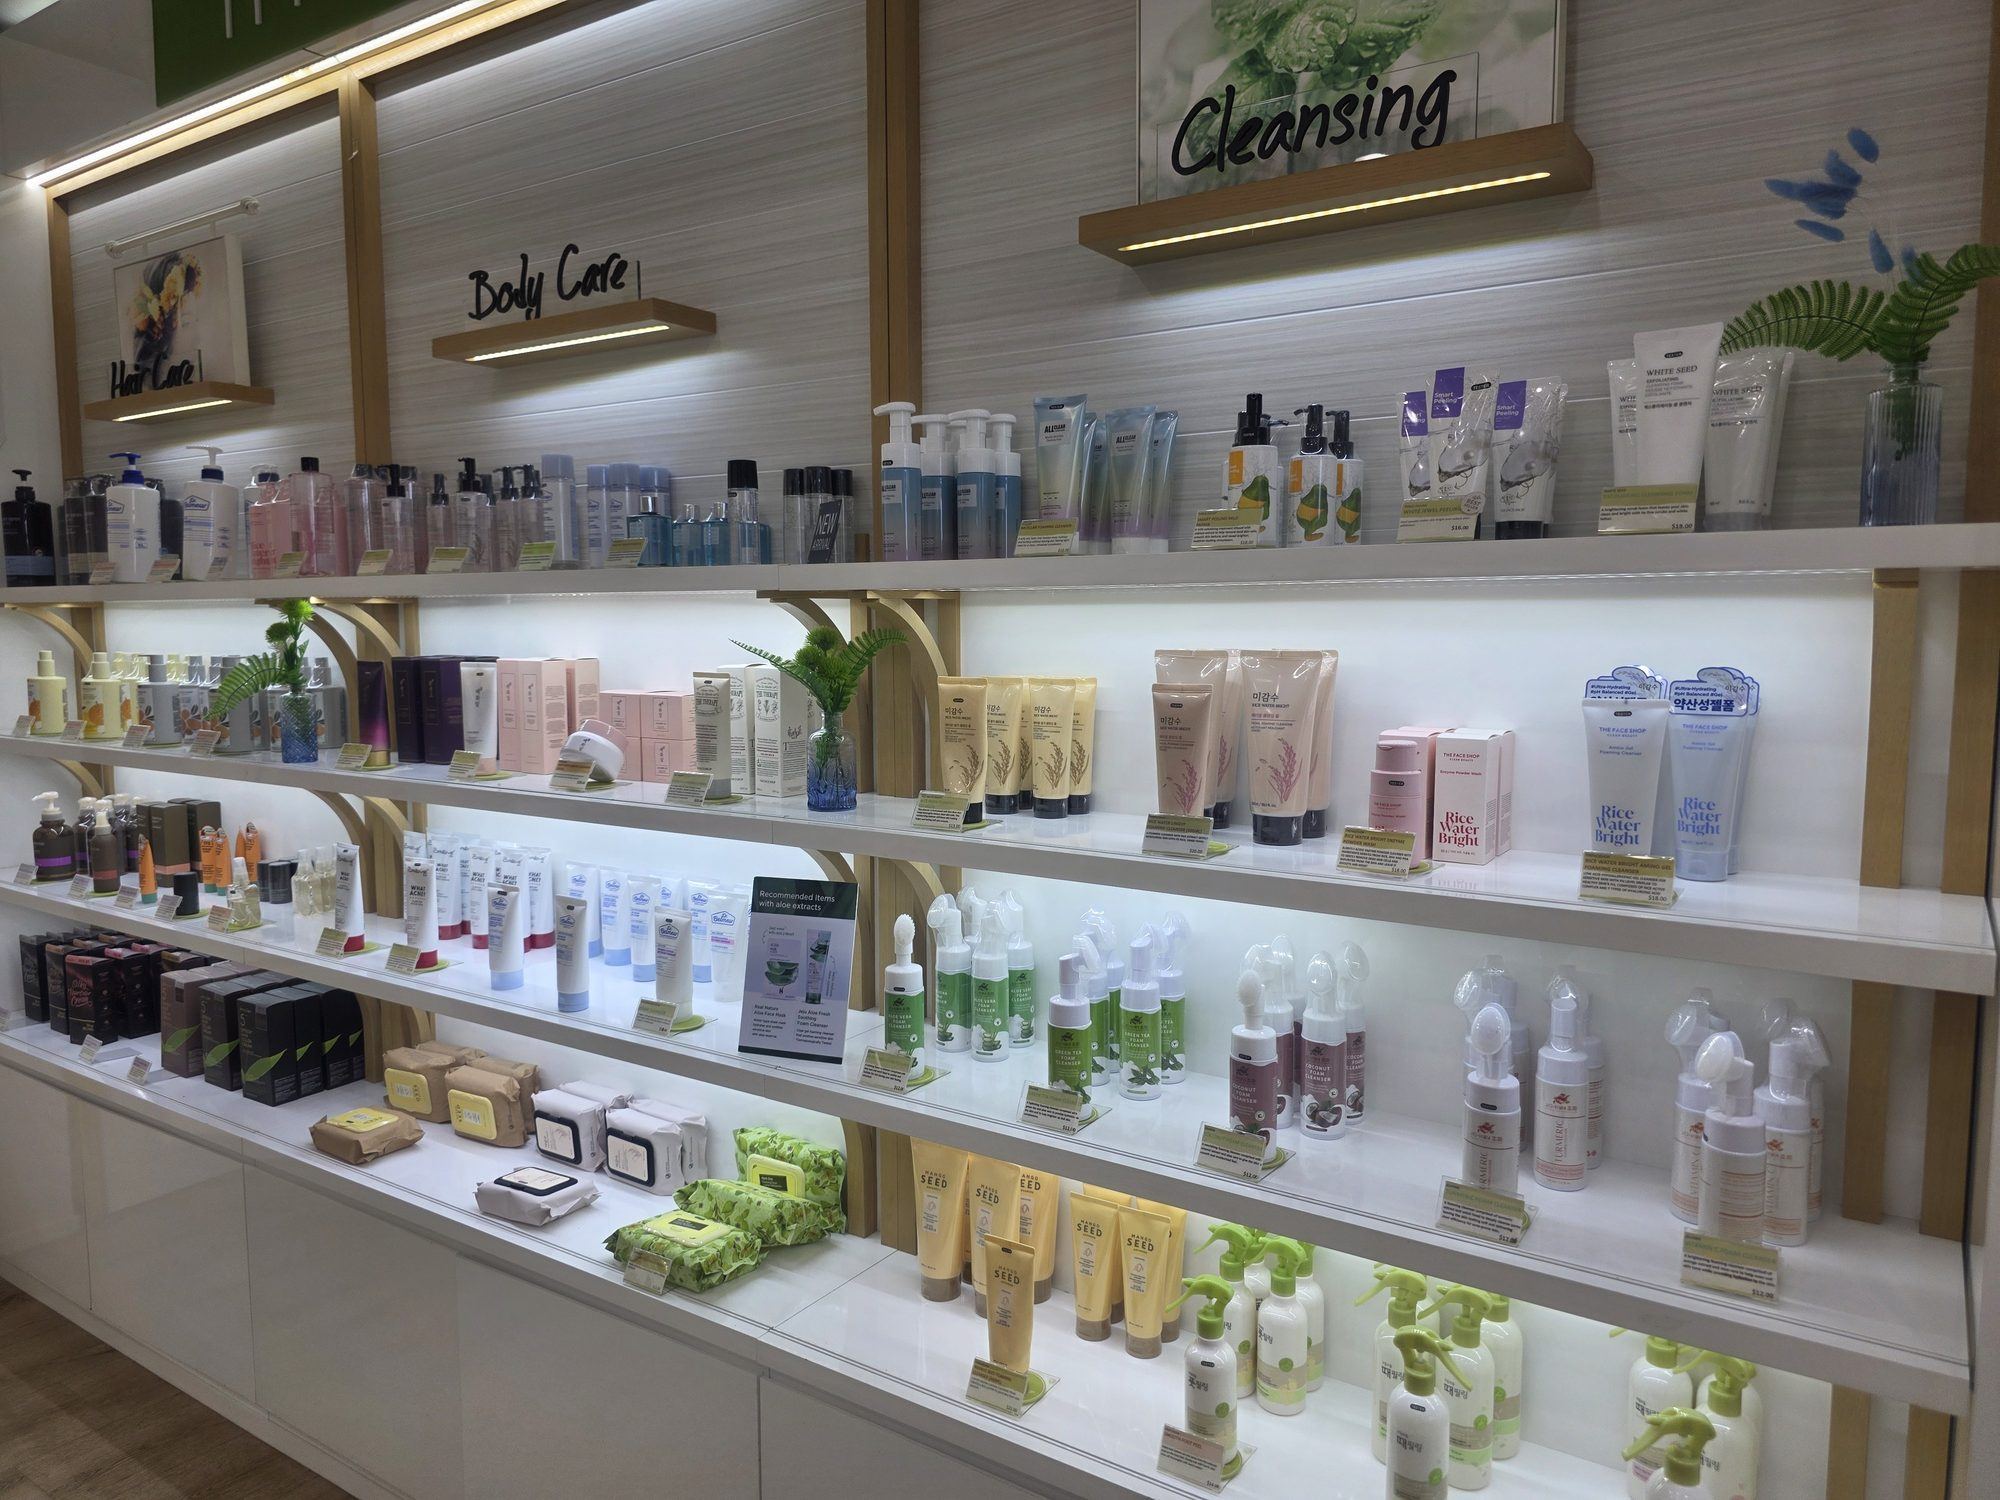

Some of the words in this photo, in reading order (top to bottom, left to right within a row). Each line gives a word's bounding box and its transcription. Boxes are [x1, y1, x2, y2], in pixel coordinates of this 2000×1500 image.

[1172, 70, 1457, 176] Cleansing
[468, 253, 544, 321] Body
[557, 243, 628, 300] Care
[111, 360, 150, 399] Hair
[152, 353, 194, 390] Care
[1646, 368, 1674, 376] WHITE
[1676, 365, 1698, 374] SEED
[1044, 425, 1054, 433] ALL
[1116, 436, 1124, 444] ALL
[816, 513, 838, 535] NEW
[764, 691, 778, 699] THERAPY
[1252, 692, 1279, 702] 미감수
[945, 707, 963, 715] 미감수
[1674, 699, 1735, 712] 약산성젤폼
[1160, 717, 1182, 725] 미감수
[1684, 797, 1716, 810] Rice
[1446, 812, 1473, 824] Rice
[1601, 805, 1634, 819] Rice
[1679, 808, 1722, 822] Water
[1440, 821, 1480, 835] Water
[1596, 817, 1641, 831] Water
[1677, 820, 1720, 837] Bright
[1439, 833, 1479, 847] Bright
[1595, 830, 1639, 846] Bright
[760, 890, 813, 900] Recommended
[759, 899, 774, 907] with
[1305, 1063, 1331, 1072] COCONUT
[1305, 1074, 1331, 1082] CLEANSER
[1232, 1083, 1256, 1093] COCONUT
[1232, 1095, 1257, 1104] CLEANSER
[1555, 1120, 1563, 1161] TURMERIC
[925, 1170, 946, 1179] MANGO
[1021, 1173, 1039, 1181] ANGO
[920, 1174, 948, 1189] SEED
[1020, 1178, 1041, 1191] EED
[976, 1188, 999, 1204] SEED
[1080, 1219, 1100, 1228] MANGO
[1076, 1223, 1102, 1238] SEED
[1127, 1237, 1154, 1252] SEED
[1131, 1233, 1152, 1243] MANGO
[994, 1269, 1020, 1285] SEED
